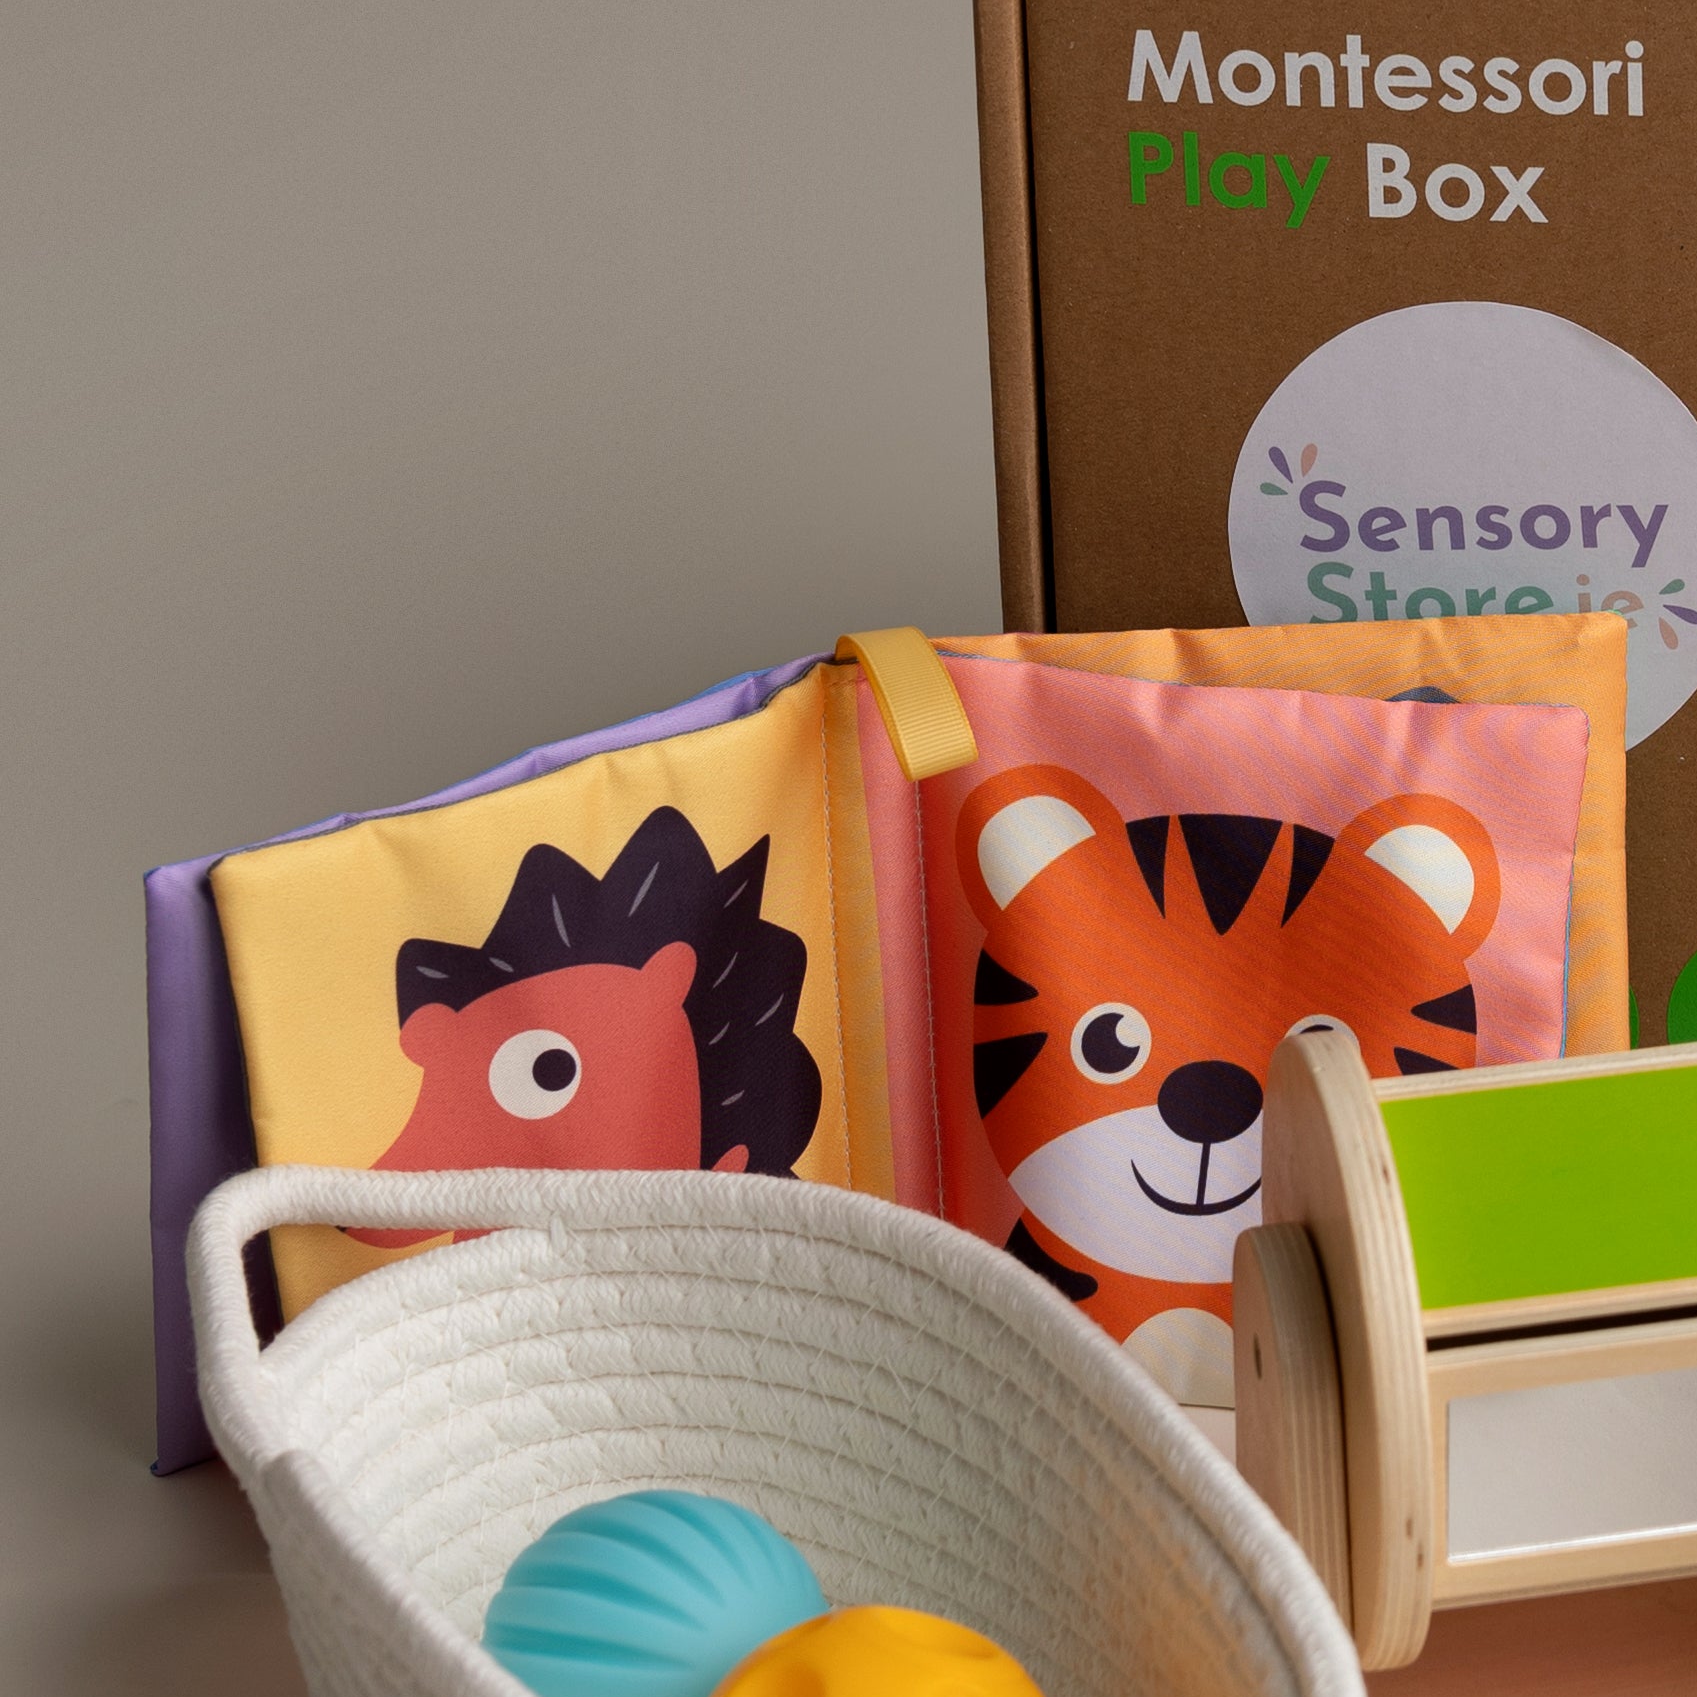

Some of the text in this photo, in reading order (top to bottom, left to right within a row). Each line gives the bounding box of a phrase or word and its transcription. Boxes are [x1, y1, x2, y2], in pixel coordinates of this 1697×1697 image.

[1127, 29, 1644, 116] Montessori
[1127, 131, 1549, 229] Play Box
[1299, 479, 1669, 568] Sensory
